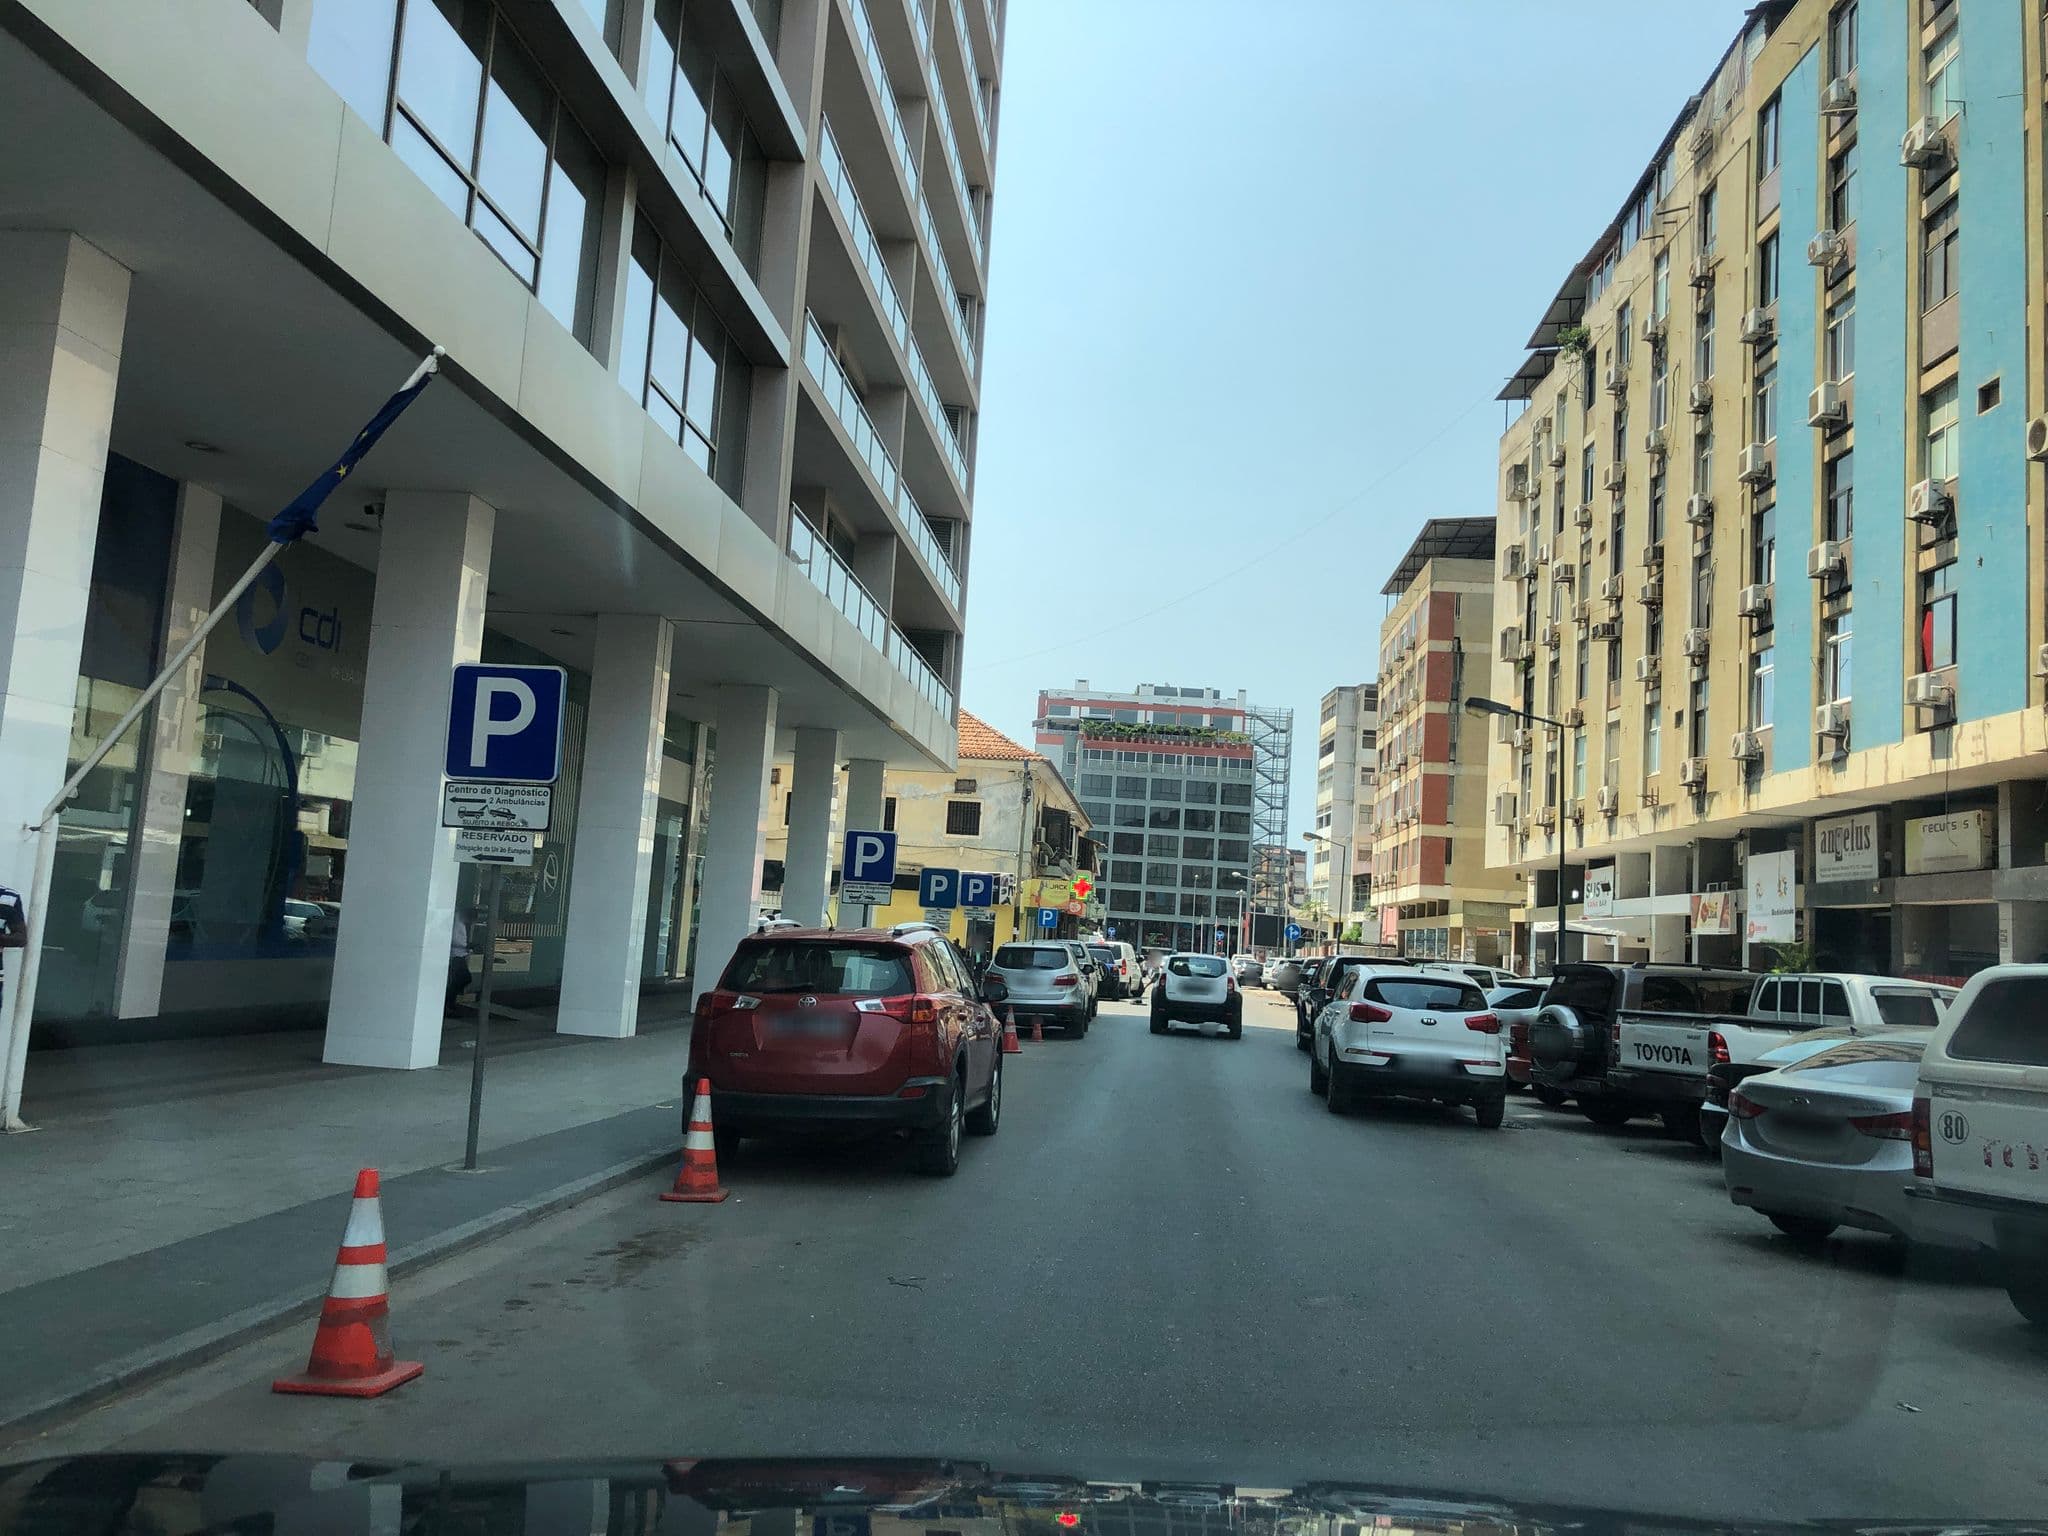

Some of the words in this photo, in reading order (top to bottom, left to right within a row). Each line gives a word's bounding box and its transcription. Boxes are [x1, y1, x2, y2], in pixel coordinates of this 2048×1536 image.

[470, 676, 536, 767] P
[448, 785, 479, 794] Centro
[480, 786, 492, 795] de
[494, 786, 549, 798] Diagnóstico
[495, 797, 546, 806] Ambulâncias
[462, 831, 528, 843] RESERVADO
[1820, 819, 1871, 862] angelus
[854, 836, 885, 877] P
[929, 874, 949, 902] P
[968, 878, 985, 902] P
[1043, 910, 1053, 925] P
[1633, 1042, 1692, 1066] TOYOTA
[1943, 1114, 1965, 1140] 80
